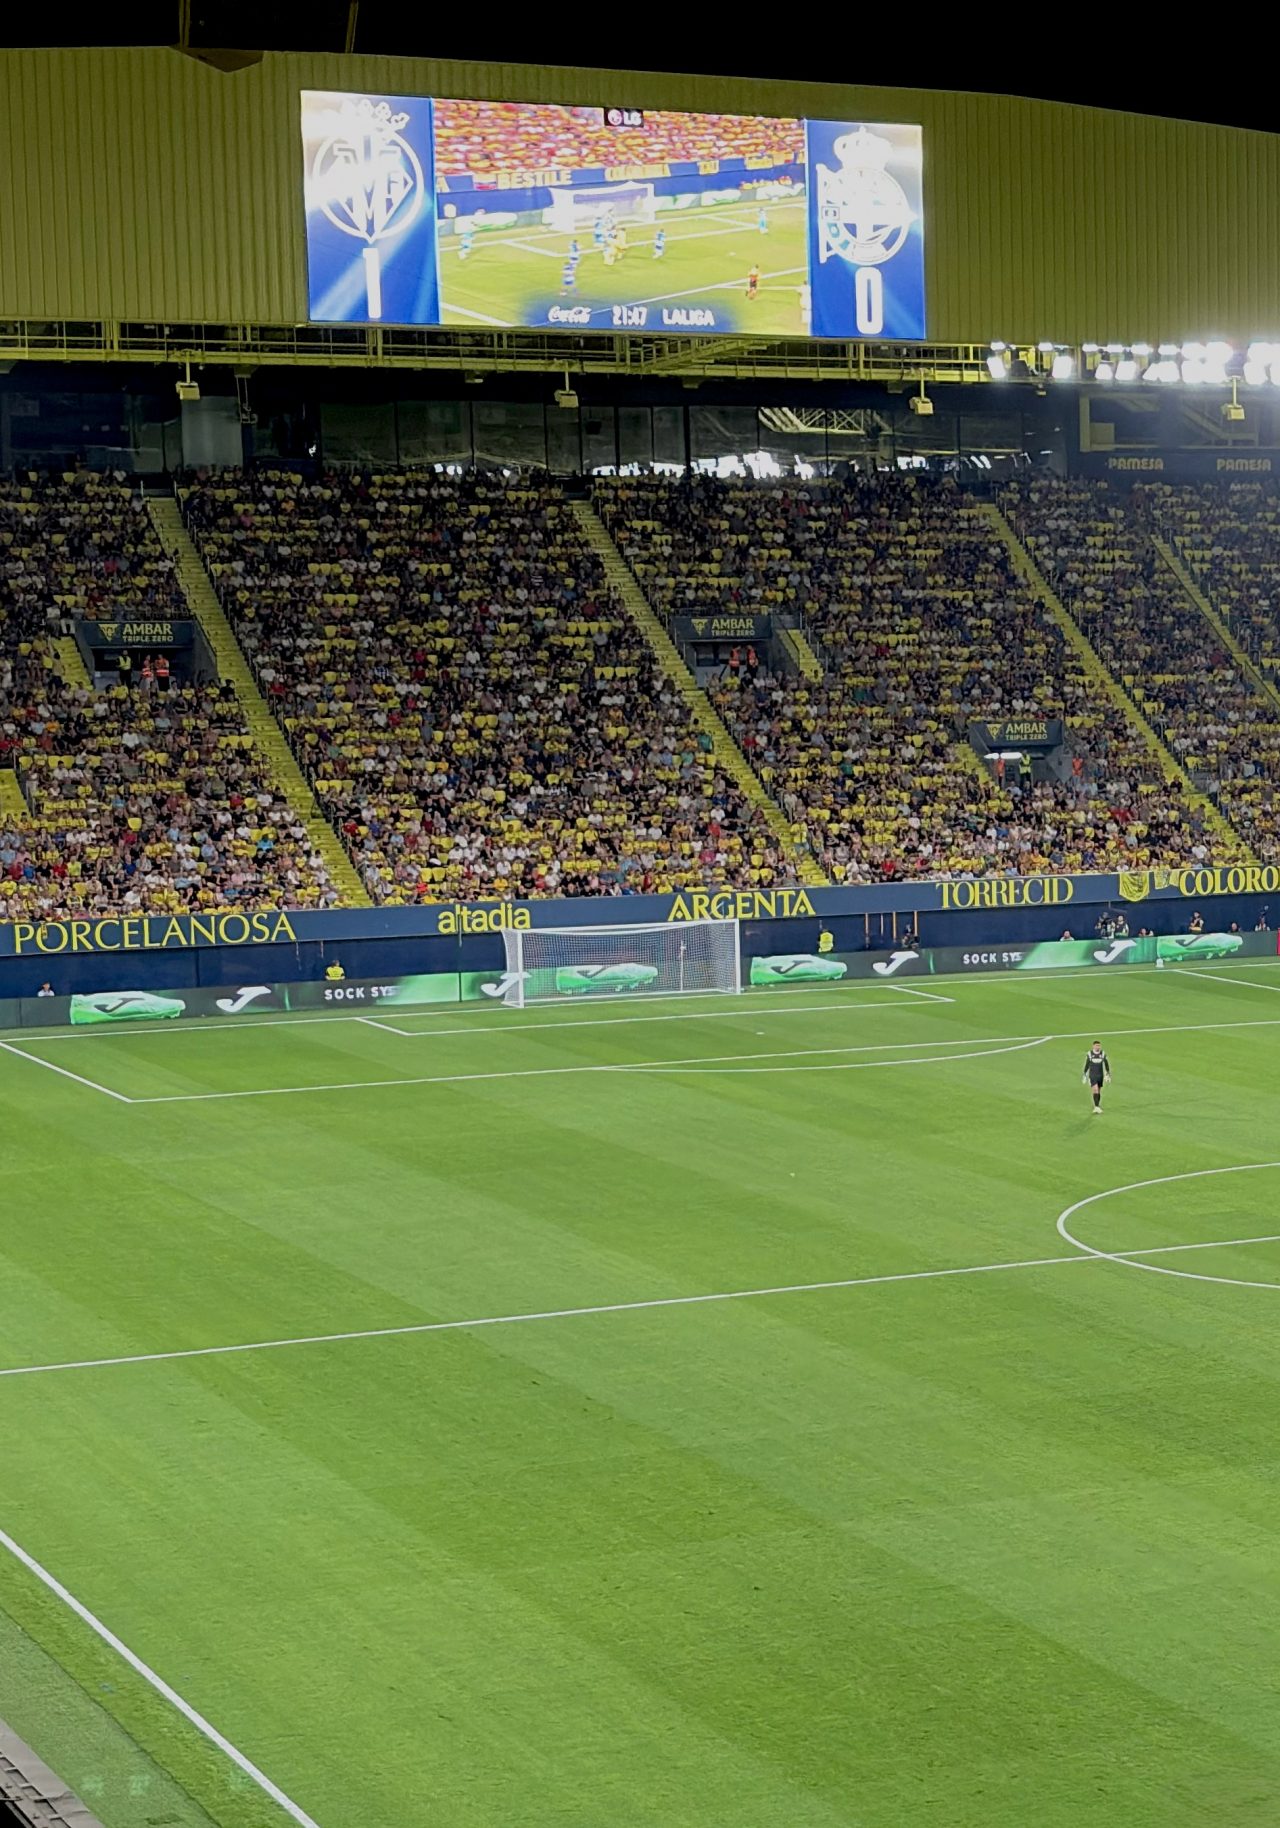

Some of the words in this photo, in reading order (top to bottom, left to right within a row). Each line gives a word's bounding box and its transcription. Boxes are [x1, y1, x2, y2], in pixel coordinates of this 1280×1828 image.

[623, 112, 642, 126] LG
[497, 170, 572, 190] BESTILE
[363, 248, 381, 318] 1
[855, 267, 883, 335] 0
[663, 308, 715, 326] LALIGA
[1107, 457, 1164, 470] PAMESA
[1216, 458, 1272, 471] PAMESA
[123, 623, 173, 635] AMBAR
[711, 619, 754, 629] AMBAR
[1005, 722, 1047, 734] AMBAR
[935, 877, 1074, 909] TORRECID
[667, 889, 817, 921] ARGENTA
[437, 903, 531, 934] altadia
[14, 912, 297, 954] PORCELANOSA
[963, 952, 997, 965] SOCK
[324, 987, 366, 1000] SOCK
